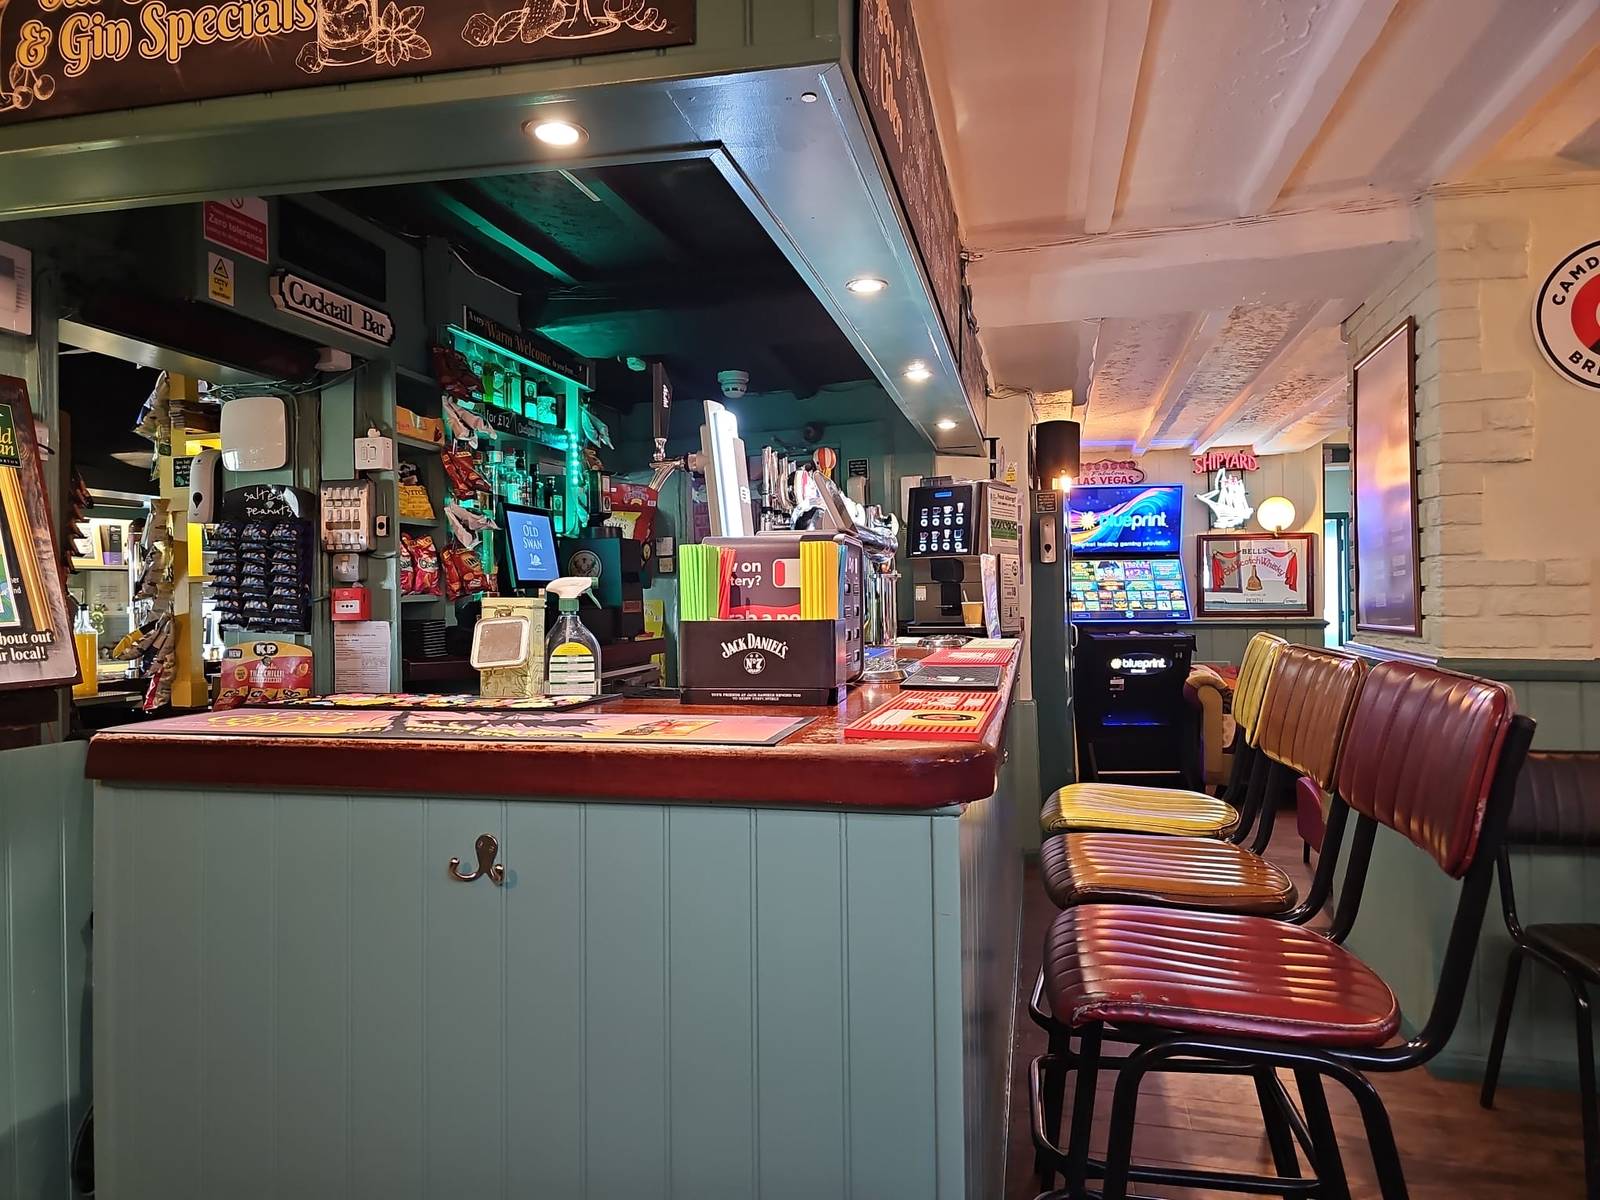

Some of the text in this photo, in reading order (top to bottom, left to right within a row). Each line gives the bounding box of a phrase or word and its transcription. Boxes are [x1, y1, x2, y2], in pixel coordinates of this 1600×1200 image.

[15, 0, 319, 77] & Gin Specials
[208, 212, 228, 229] Zero
[229, 221, 264, 245] tolerance
[214, 277, 229, 287] CCTV
[1552, 256, 1600, 305] CAMD
[289, 280, 386, 338] Cocktail Bar
[486, 320, 514, 348] Warm
[514, 334, 552, 366] Welcome
[497, 414, 511, 429] £12
[0, 428, 12, 445] ld
[0, 444, 15, 456] an
[1195, 452, 1258, 474] SHIPYARD
[1100, 475, 1135, 485] VEGAS
[243, 486, 285, 502] salted
[246, 505, 293, 518] peanuts
[1099, 511, 1167, 530] blueprint
[522, 524, 539, 537] OLD
[522, 536, 543, 550] SWAN
[741, 561, 761, 573] on
[1260, 557, 1285, 577] Whisky
[729, 575, 761, 588] tery?
[0, 631, 52, 646] hout out
[720, 632, 789, 660] JACK DANIEL'S
[10, 646, 46, 661] local!
[255, 643, 277, 656] KP
[1122, 657, 1166, 670] blueprint
